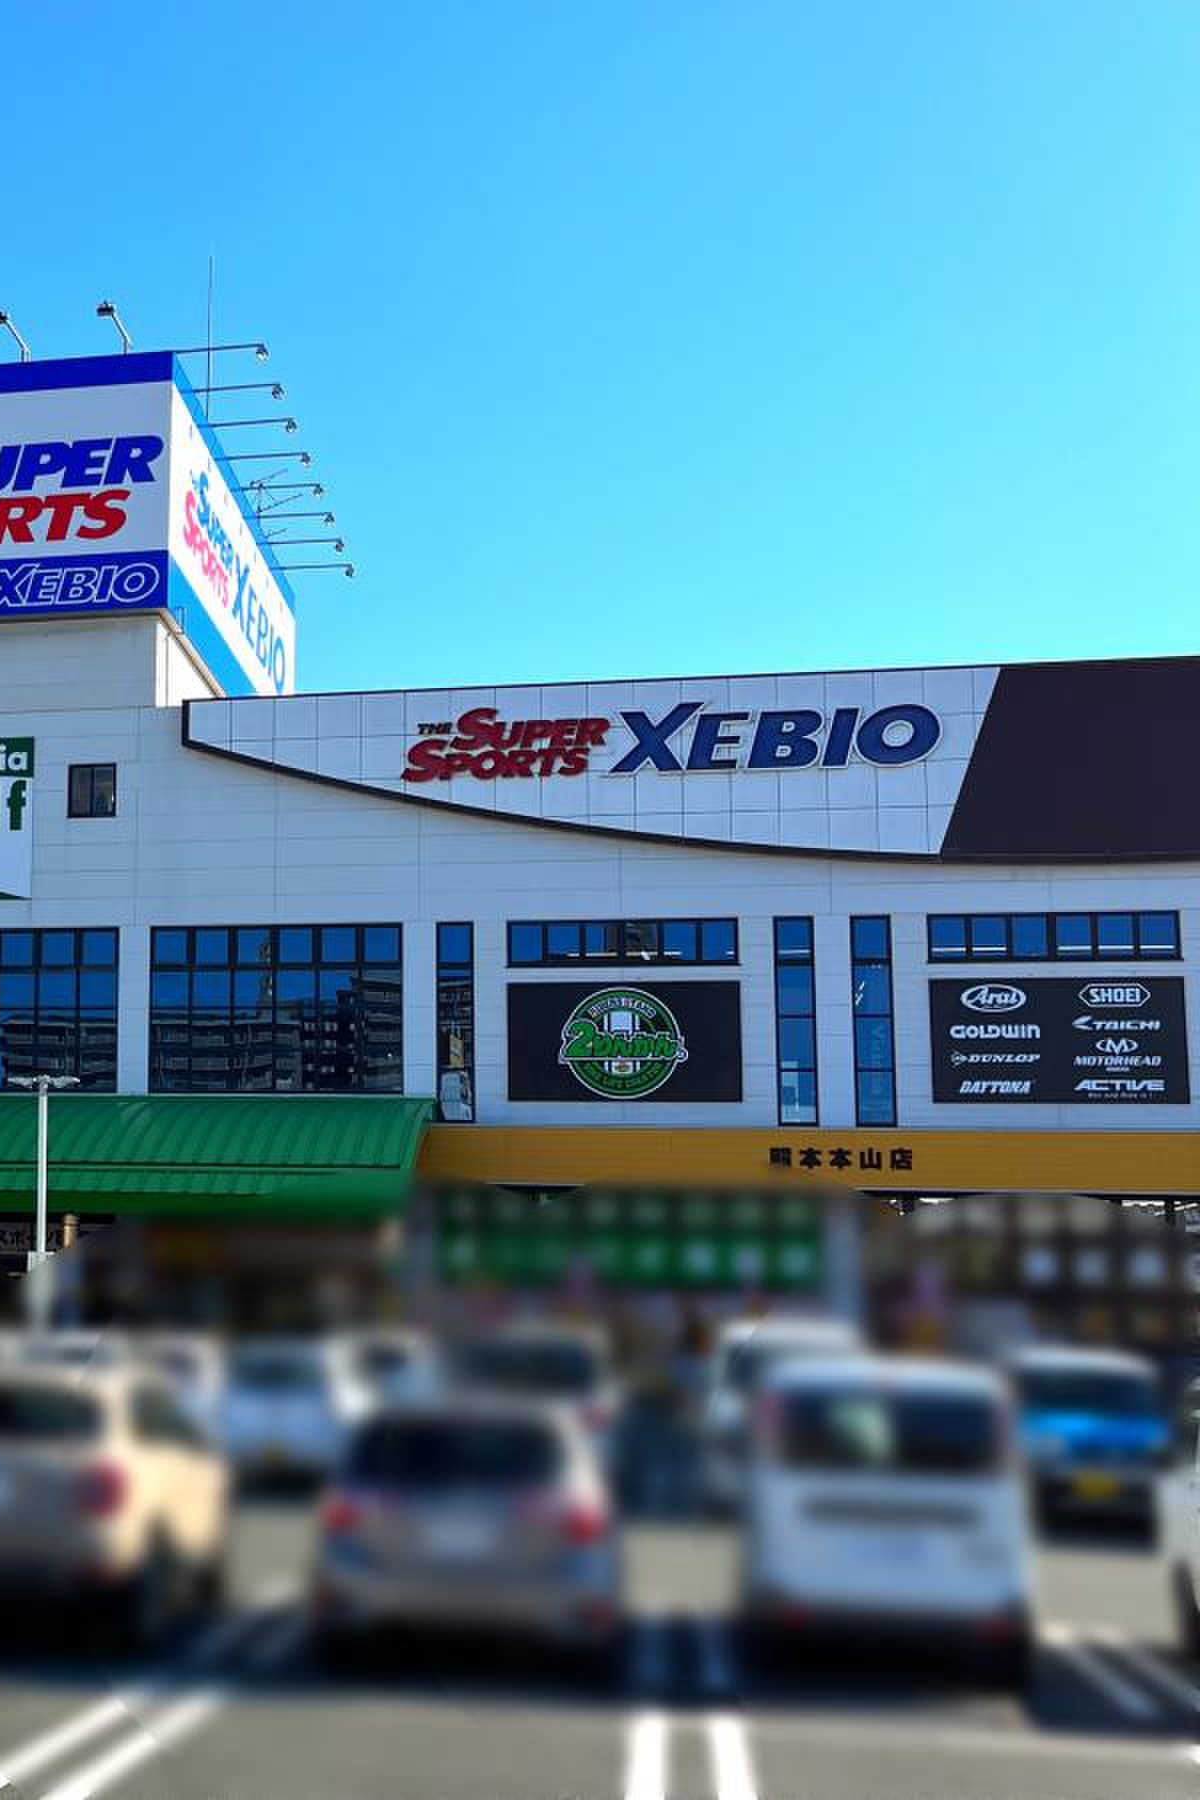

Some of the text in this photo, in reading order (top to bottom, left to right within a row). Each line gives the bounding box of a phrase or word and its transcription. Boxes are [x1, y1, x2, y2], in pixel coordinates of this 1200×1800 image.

[183, 490, 230, 609] SPORTS
[232, 552, 286, 695] XEBIO
[417, 708, 611, 751] THE SUPER
[609, 702, 942, 775] XEBIO
[400, 738, 591, 783] SPORTS
[1089, 987, 1141, 1003] SHOEI
[950, 1024, 1041, 1039] GOLDWIN
[968, 1053, 1041, 1064] DUNLOP
[1073, 1055, 1162, 1067] MOTORHEAD
[959, 1080, 1032, 1094] DAYTONA
[1073, 1079, 1166, 1091] ACTIVE
[768, 1146, 914, 1172] 熊本本山店
